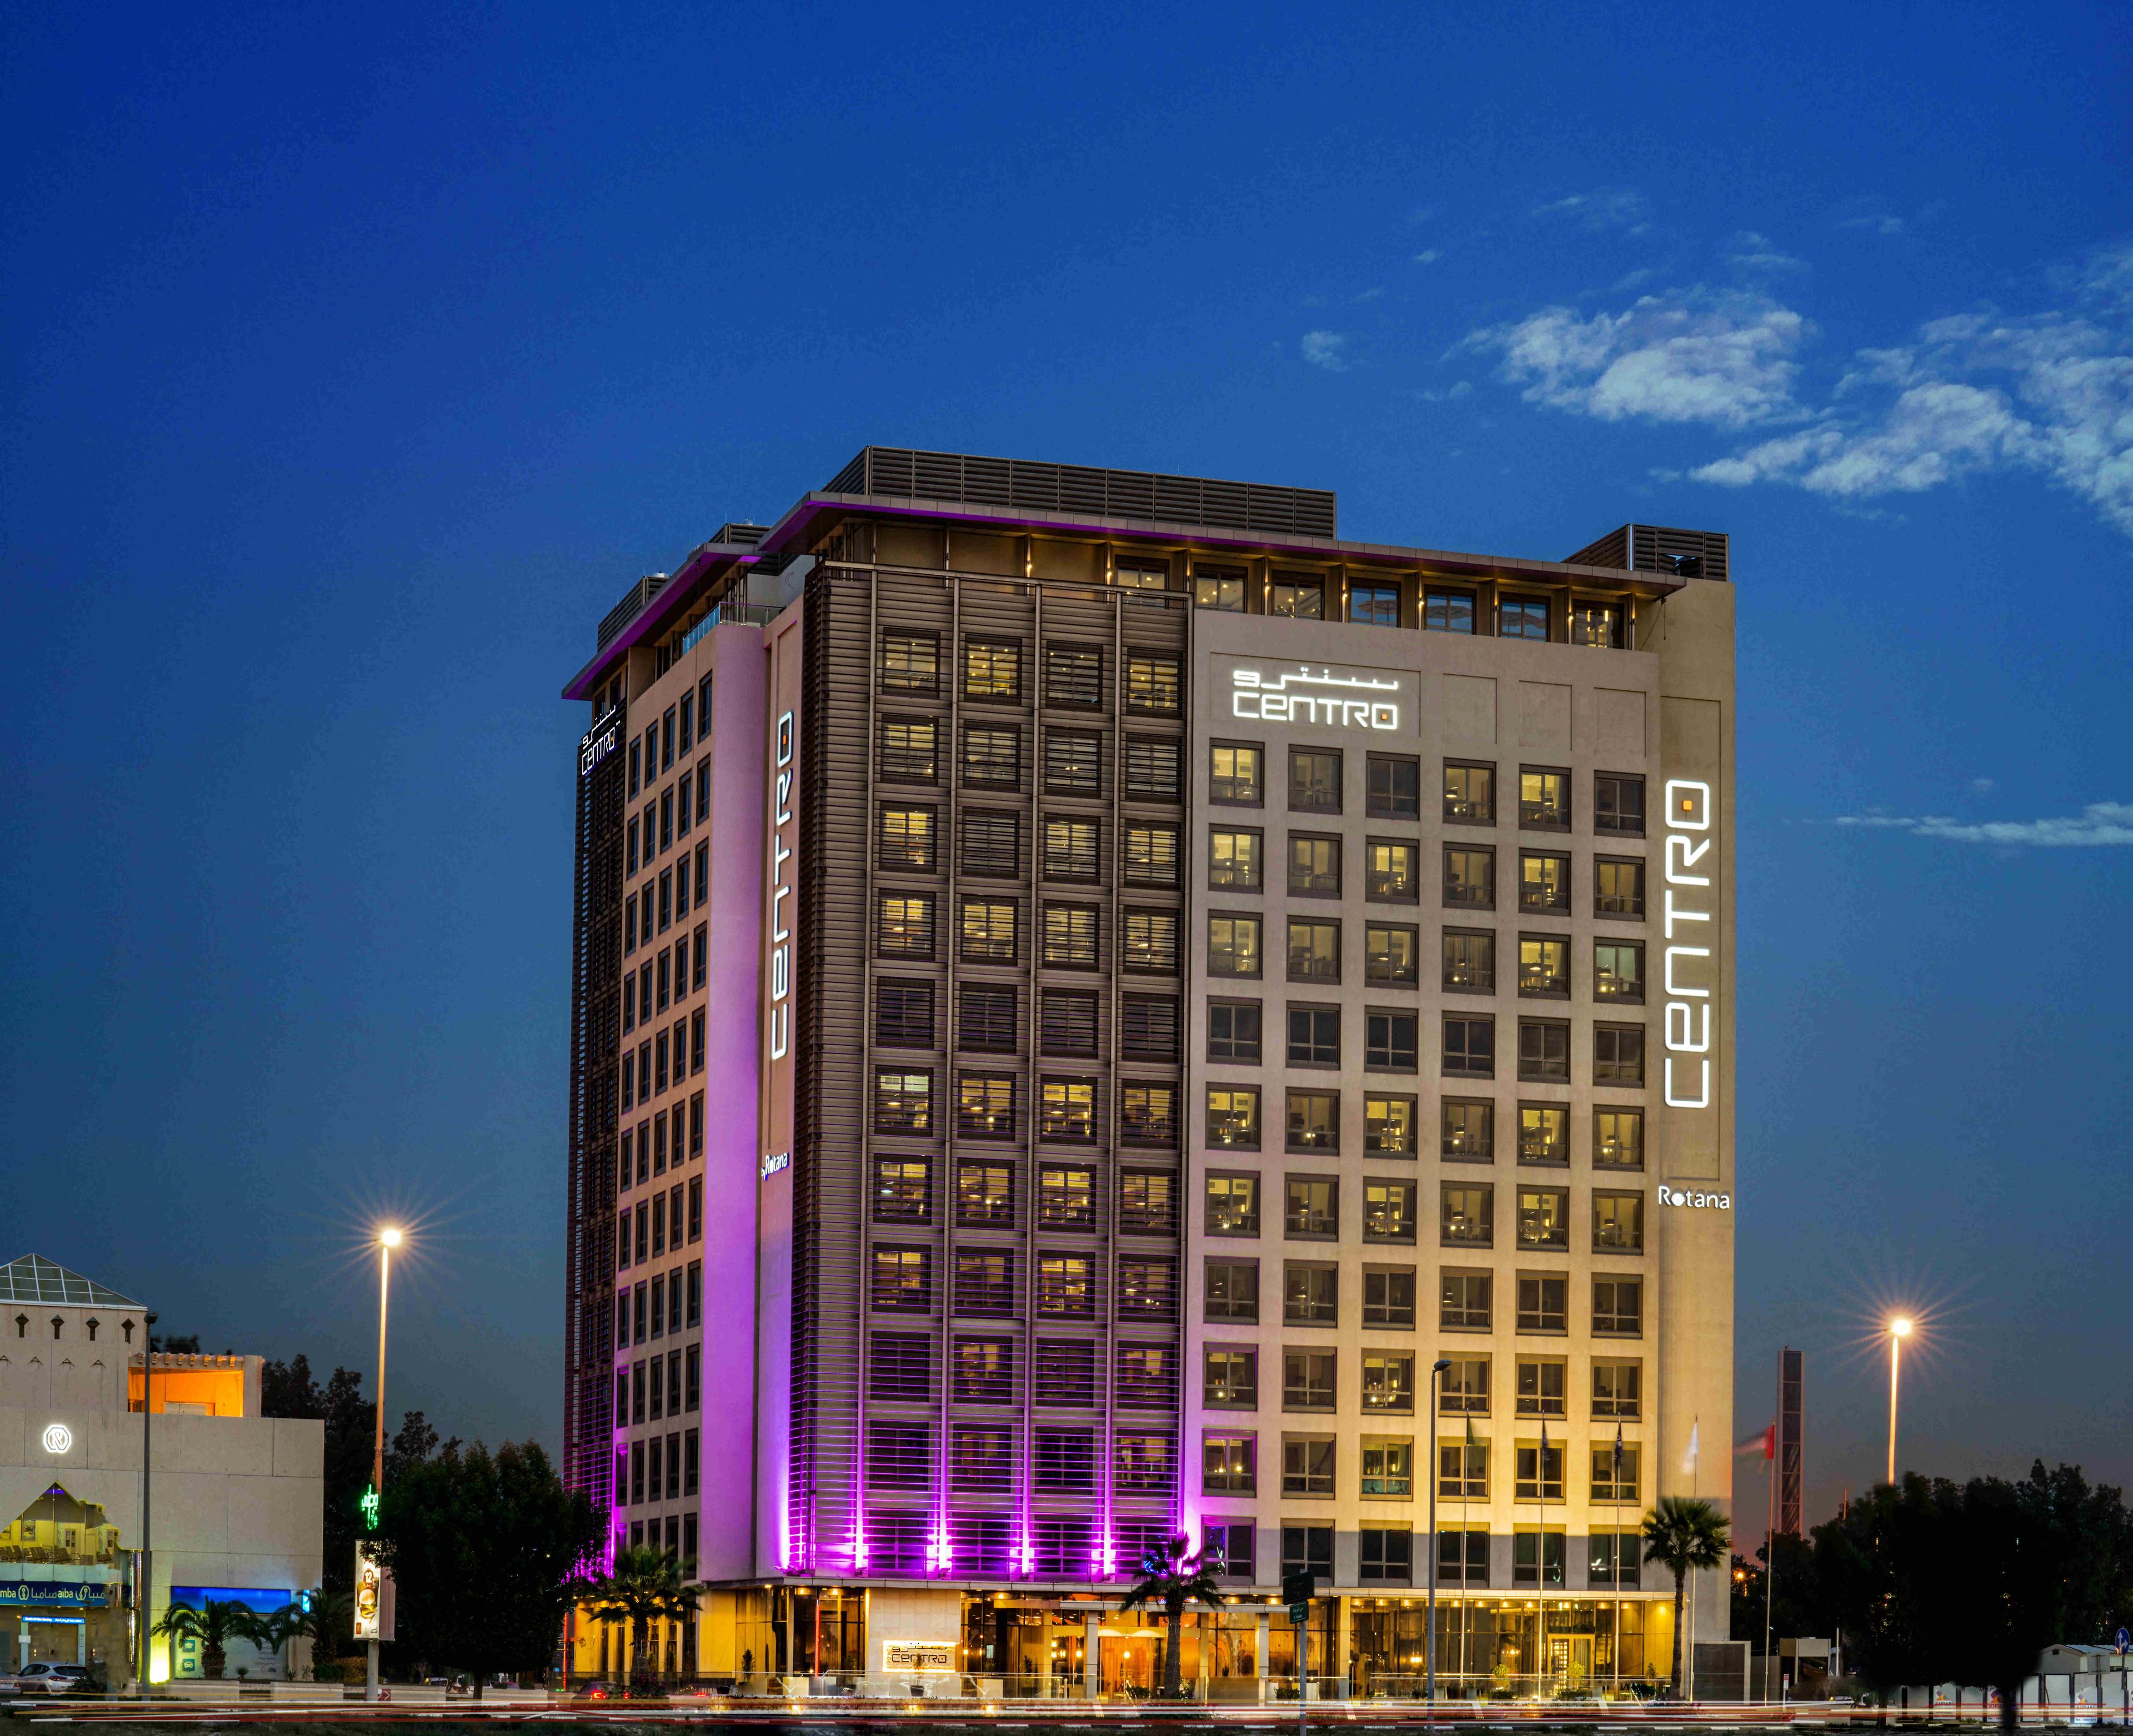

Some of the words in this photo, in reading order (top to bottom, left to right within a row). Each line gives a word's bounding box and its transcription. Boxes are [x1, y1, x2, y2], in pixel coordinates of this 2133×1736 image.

[765, 1152, 788, 1175] Rotana
[1658, 1186, 1730, 1209] Rotana
[365, 1571, 372, 1583] 12
